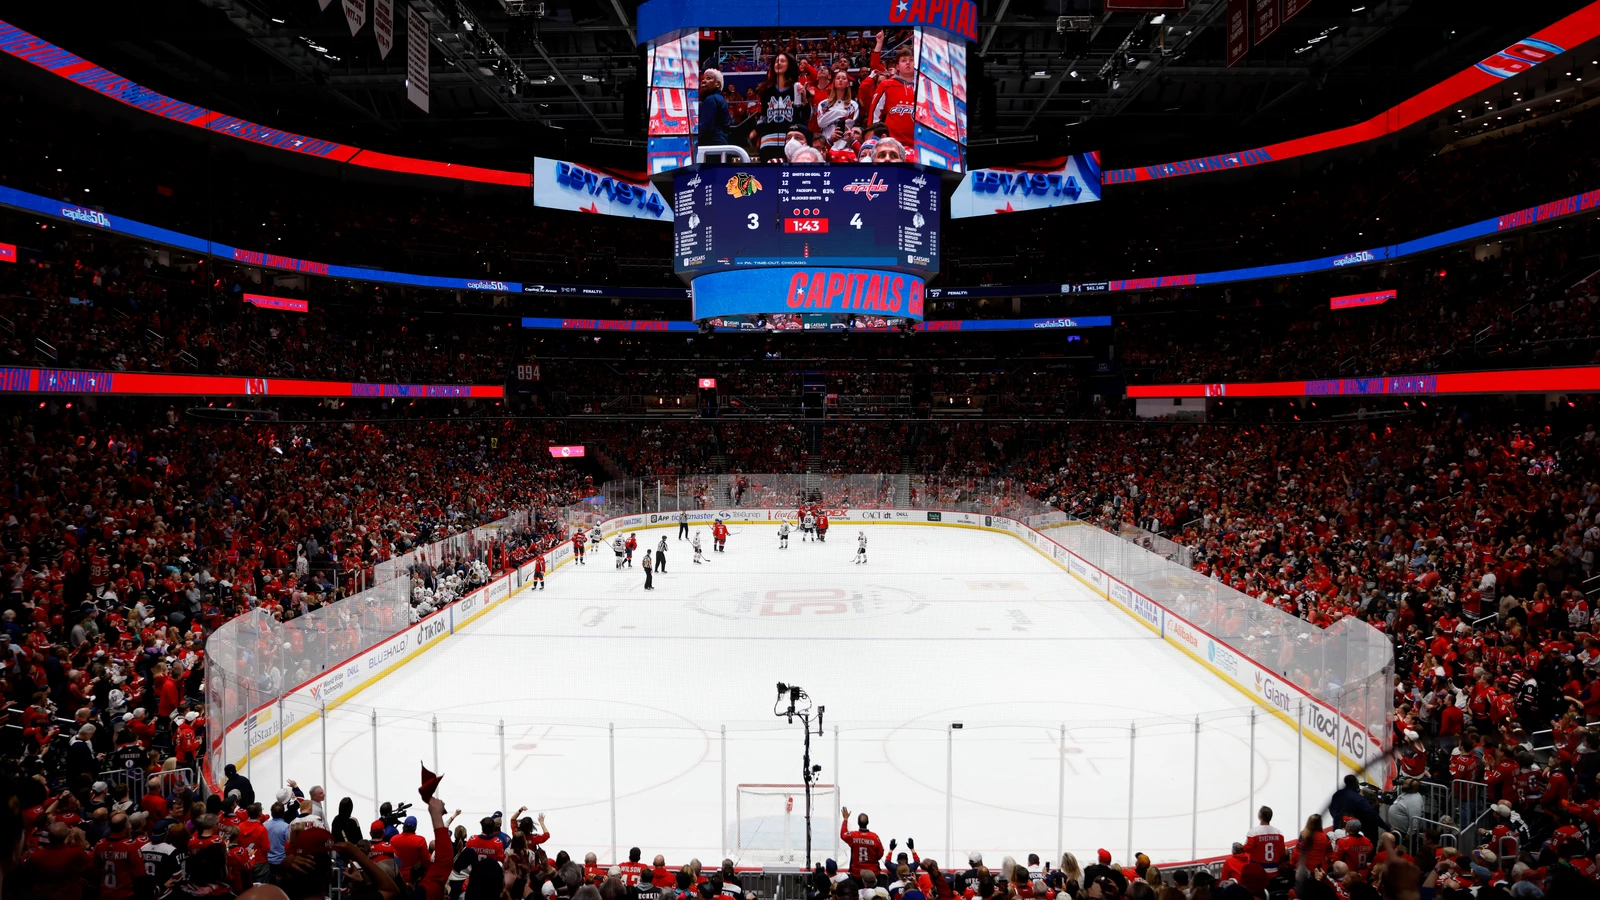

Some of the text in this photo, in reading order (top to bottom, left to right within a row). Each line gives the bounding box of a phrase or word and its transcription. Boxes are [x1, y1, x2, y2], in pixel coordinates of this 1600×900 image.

[1146, 148, 1272, 178] WASHINGTON
[747, 213, 759, 231] 3
[850, 213, 863, 230] 4
[1498, 208, 1535, 231] CAPITALS
[1536, 196, 1577, 221] CAPITALS
[793, 220, 820, 231] 1:43
[266, 254, 298, 270] CAPITALS
[299, 260, 328, 275] CAPITALS
[786, 271, 904, 312] CAPITALS
[39, 370, 114, 393] WASHINGTON
[517, 365, 541, 380] 894
[424, 617, 446, 643] TikTok
[1174, 624, 1198, 648] Alibaba
[368, 640, 405, 670] BLUEHALO
[323, 672, 344, 690] World Wide
[347, 664, 360, 678] DELL
[323, 682, 344, 697] Technology
[1264, 679, 1290, 712] Giant
[1308, 703, 1364, 760] iTech AG
[853, 838, 876, 847] OVECHKIN
[1265, 842, 1275, 862] 8
[858, 847, 869, 862] 8
[1357, 853, 1366, 870] 8
[104, 860, 117, 889] 8
